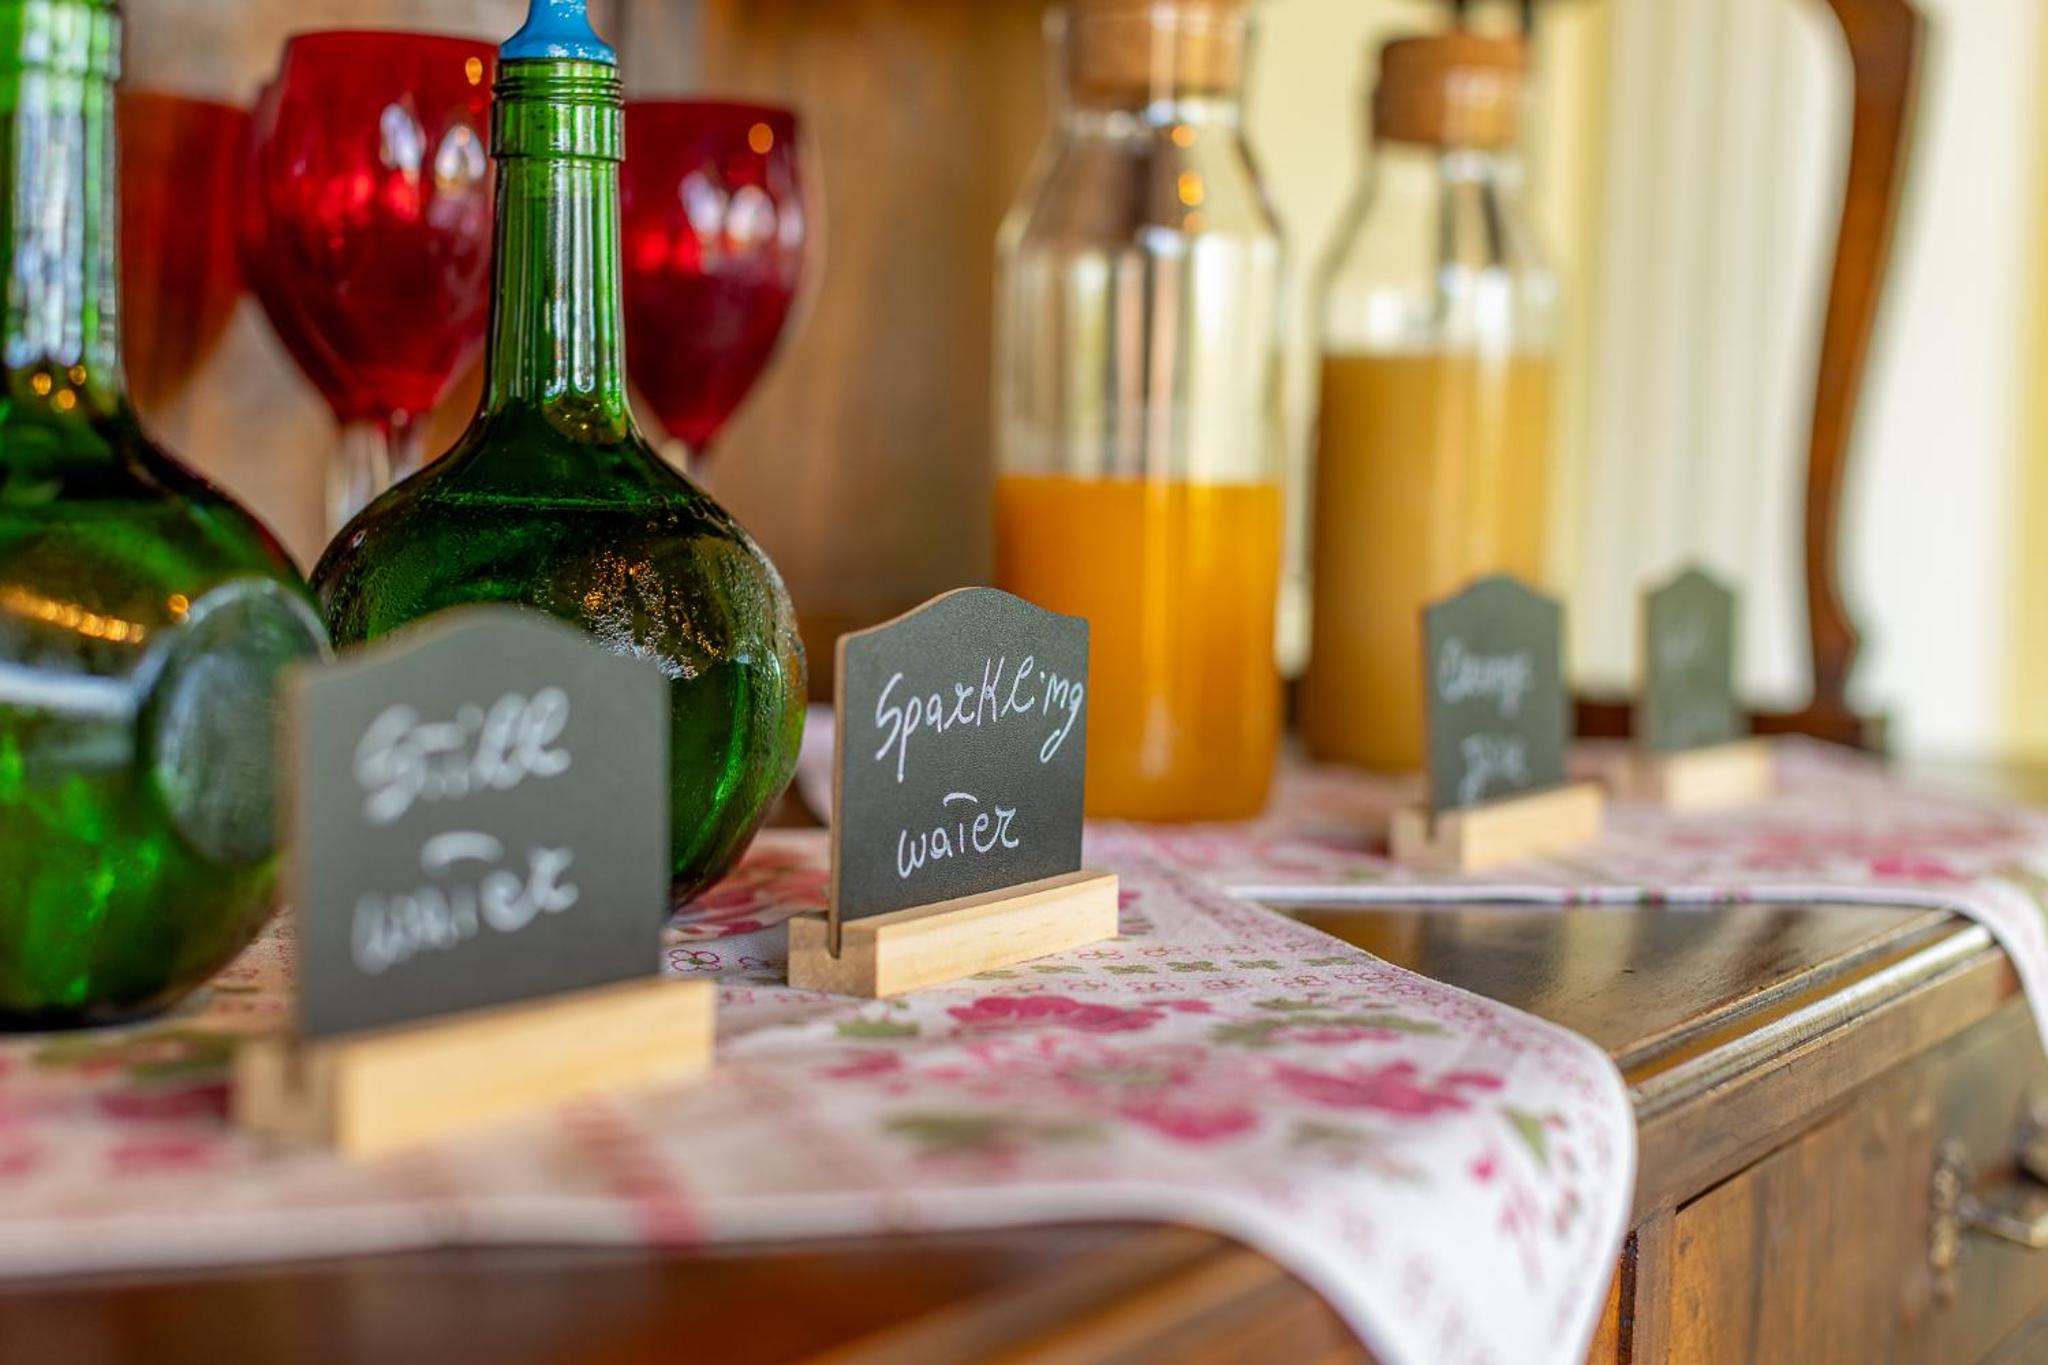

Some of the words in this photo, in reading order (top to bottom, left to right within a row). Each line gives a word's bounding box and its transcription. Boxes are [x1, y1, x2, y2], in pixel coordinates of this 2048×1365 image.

[355, 687, 571, 823] Still
[351, 831, 579, 974] water
[897, 792, 1020, 879] water
